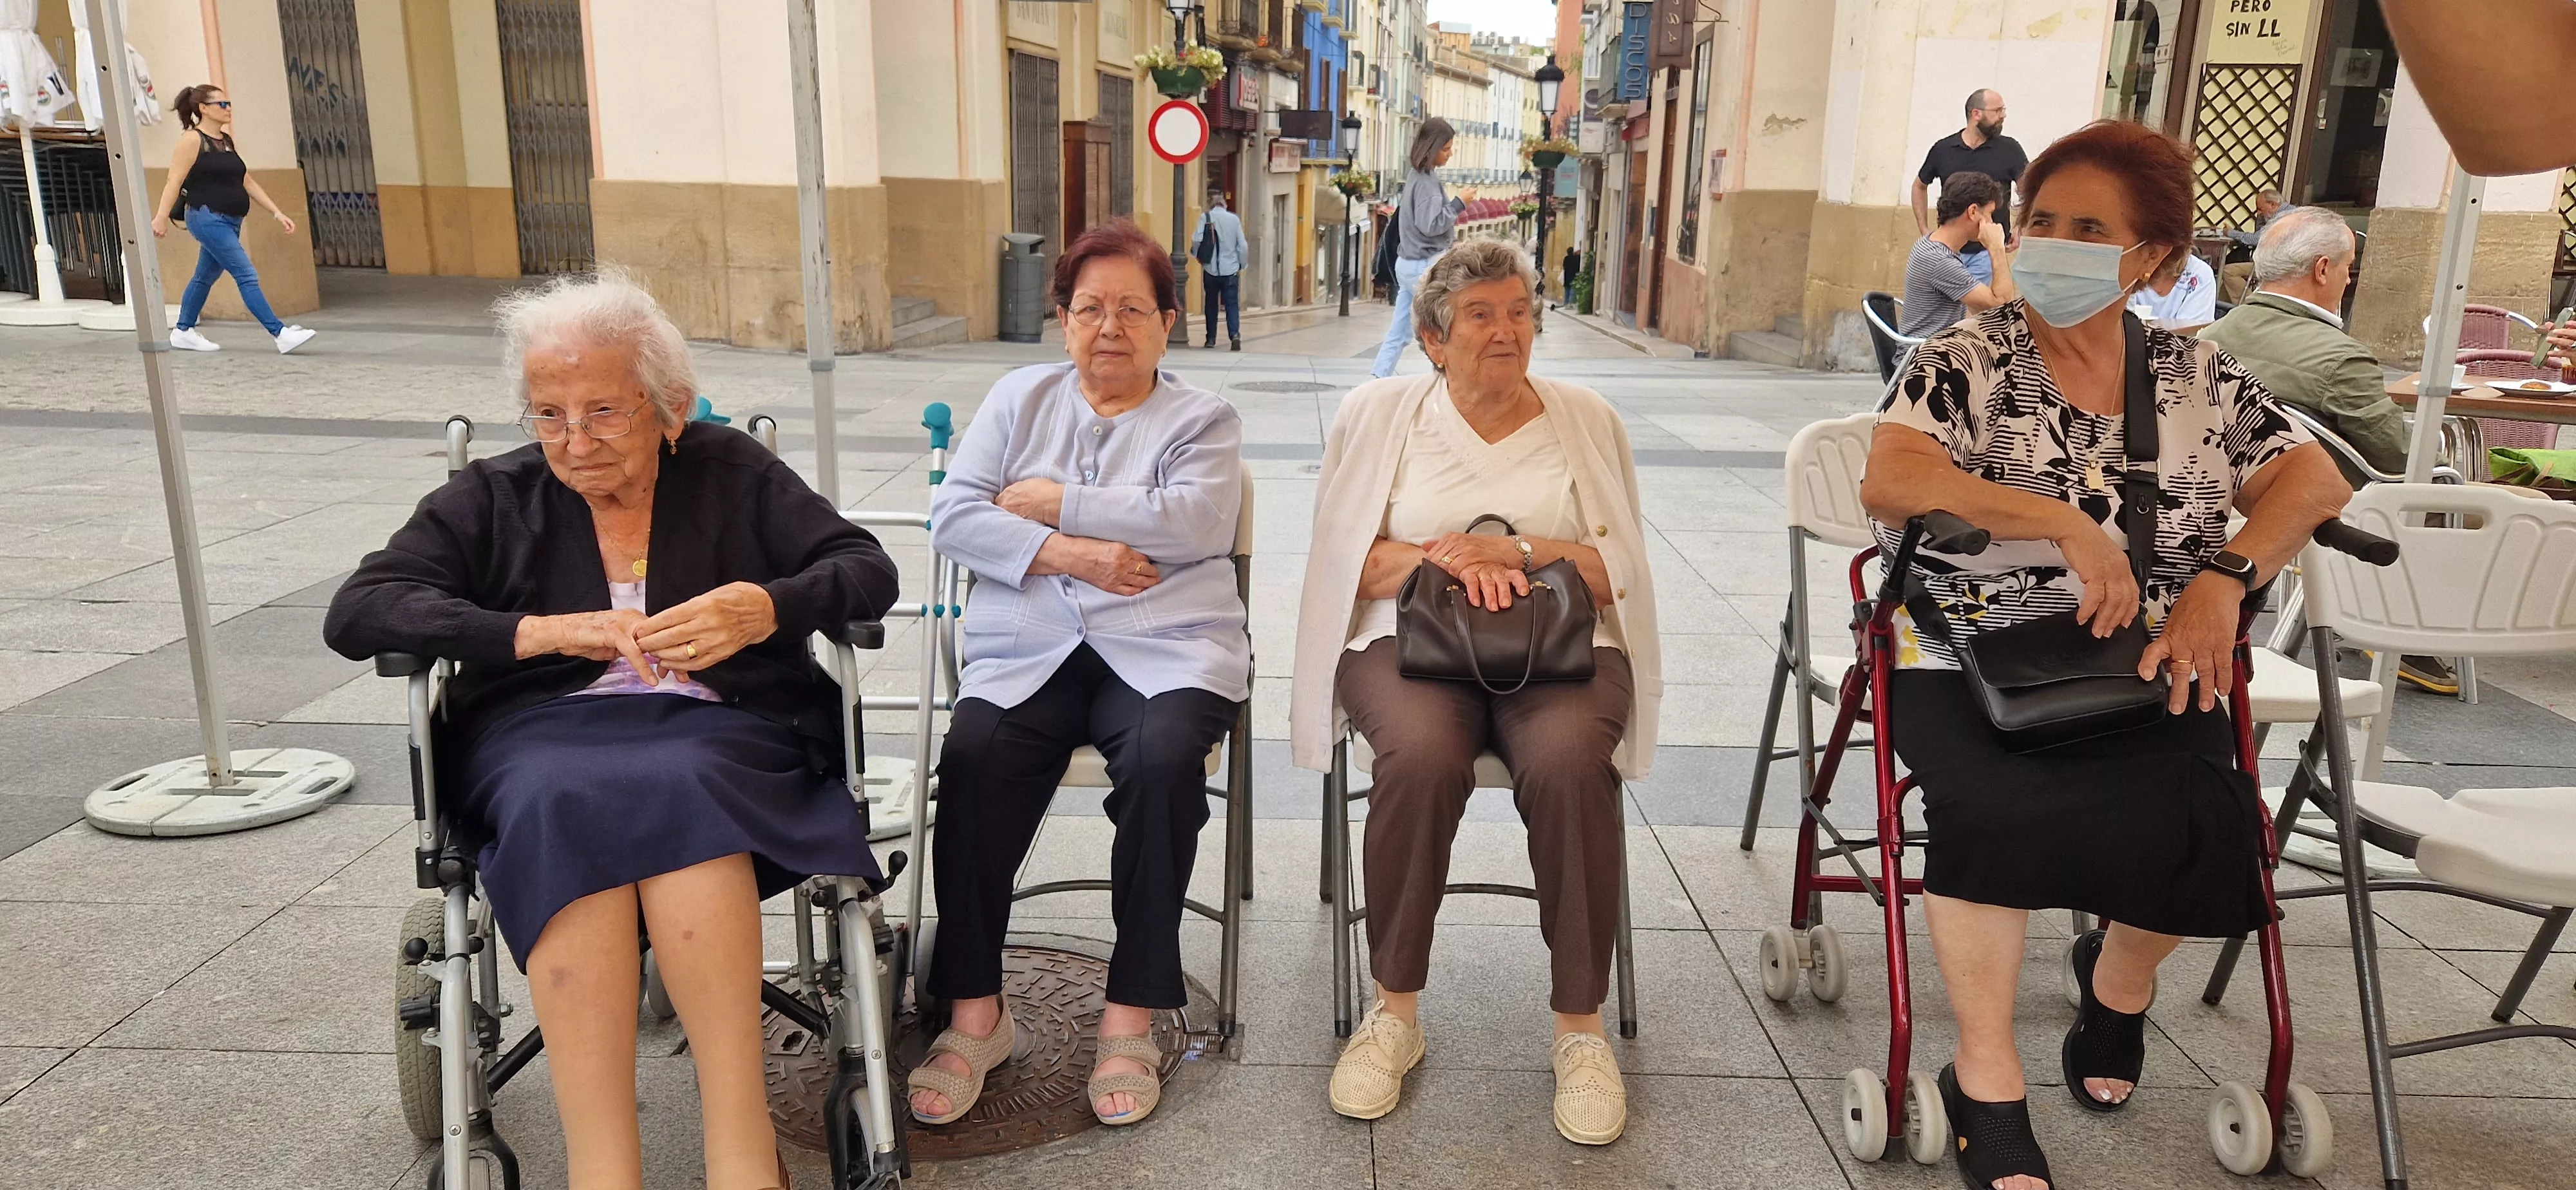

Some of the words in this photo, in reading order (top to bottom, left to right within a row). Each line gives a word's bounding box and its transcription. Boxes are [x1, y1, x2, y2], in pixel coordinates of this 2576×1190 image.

[2230, 0, 2271, 13] PERO
[2226, 21, 2251, 39] SIN
[2257, 18, 2281, 38] LL
[1624, 3, 1647, 99] DISCOS
